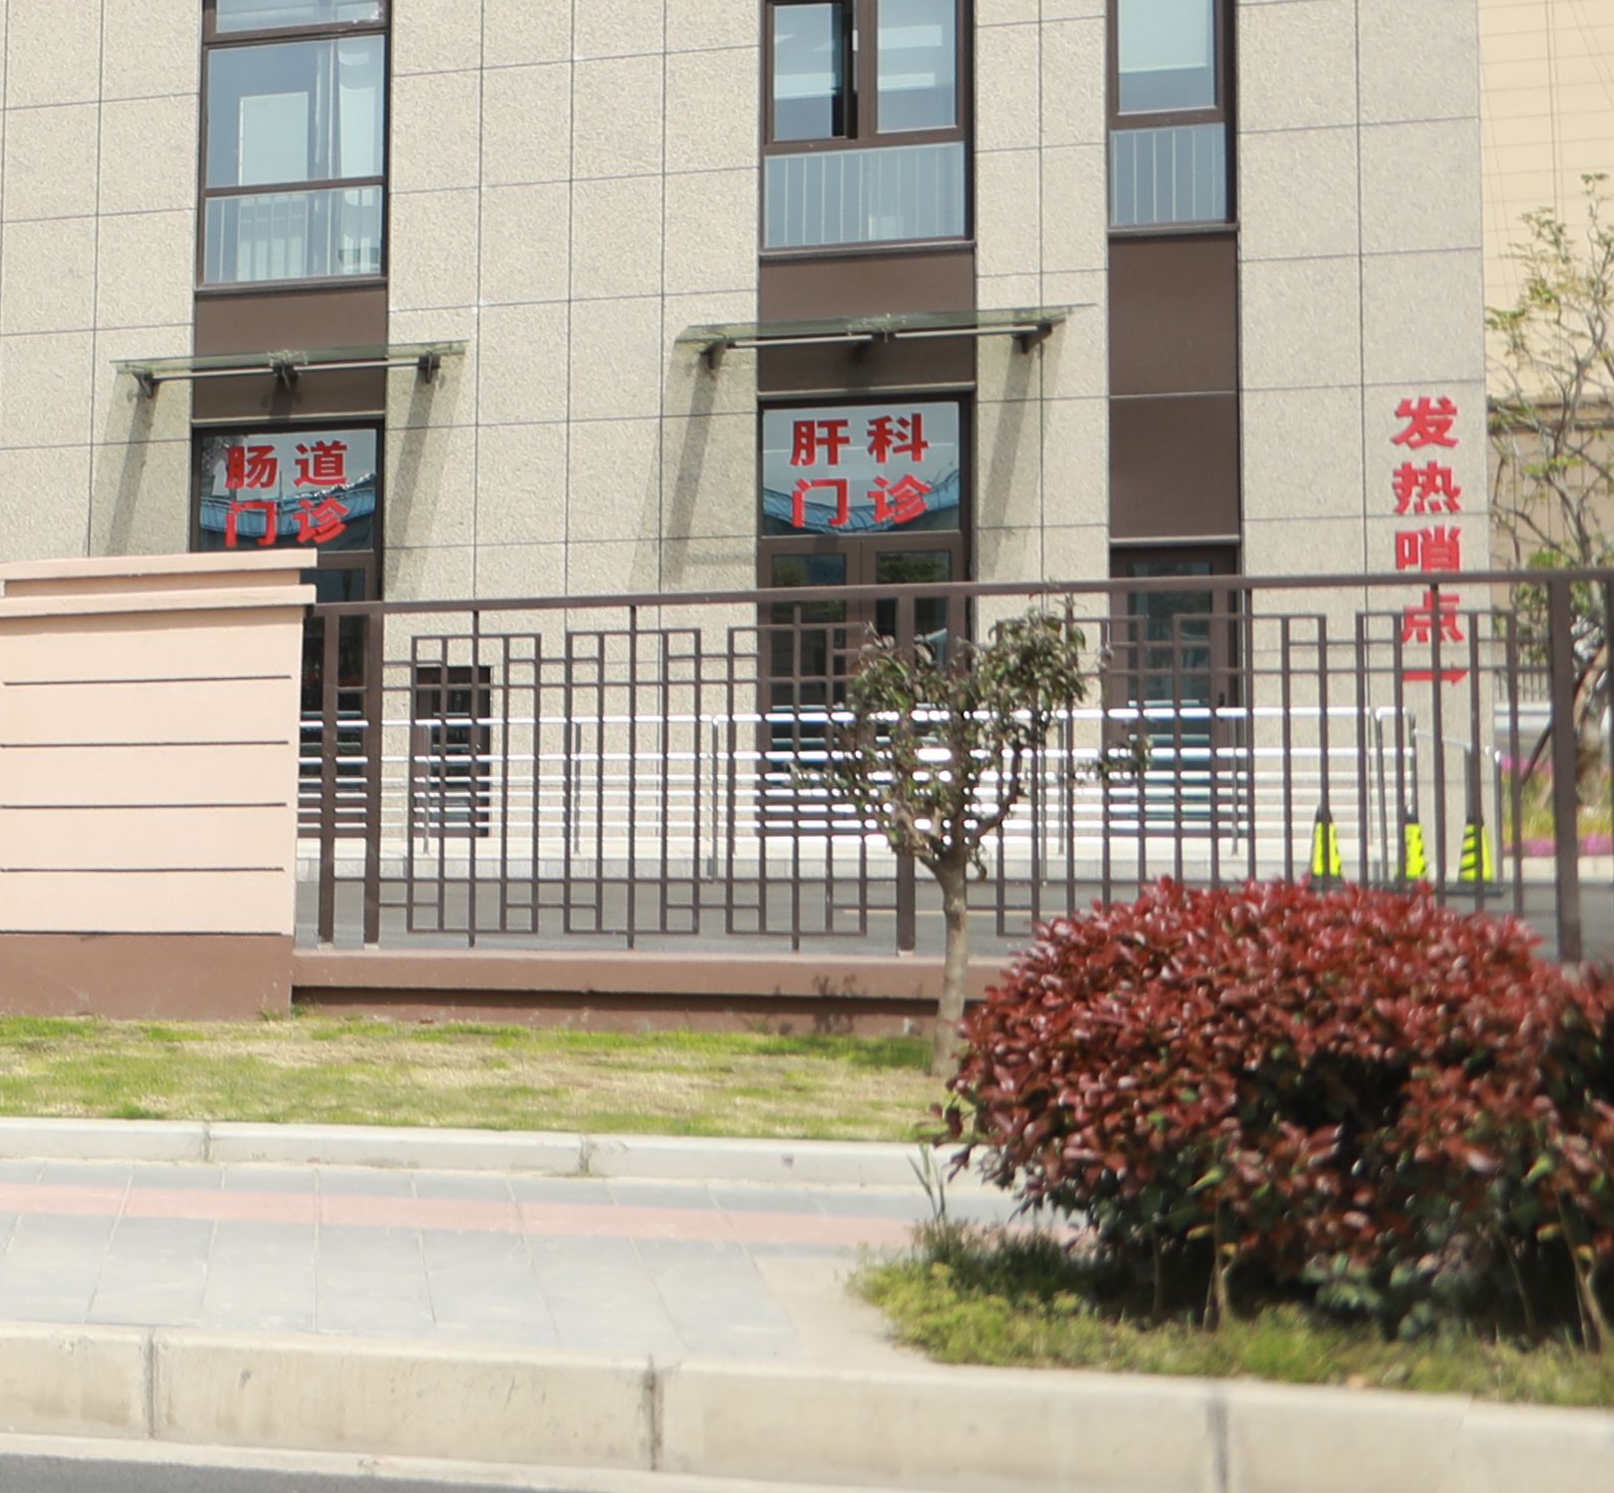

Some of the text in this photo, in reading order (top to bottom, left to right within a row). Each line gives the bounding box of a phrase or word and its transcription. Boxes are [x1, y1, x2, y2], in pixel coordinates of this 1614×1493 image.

[225, 440, 348, 490] 肠道
[791, 414, 929, 466] 肝科
[224, 498, 349, 549] 门诊
[791, 475, 931, 528] 门诊
[1391, 396, 1465, 644] 发热哨点
